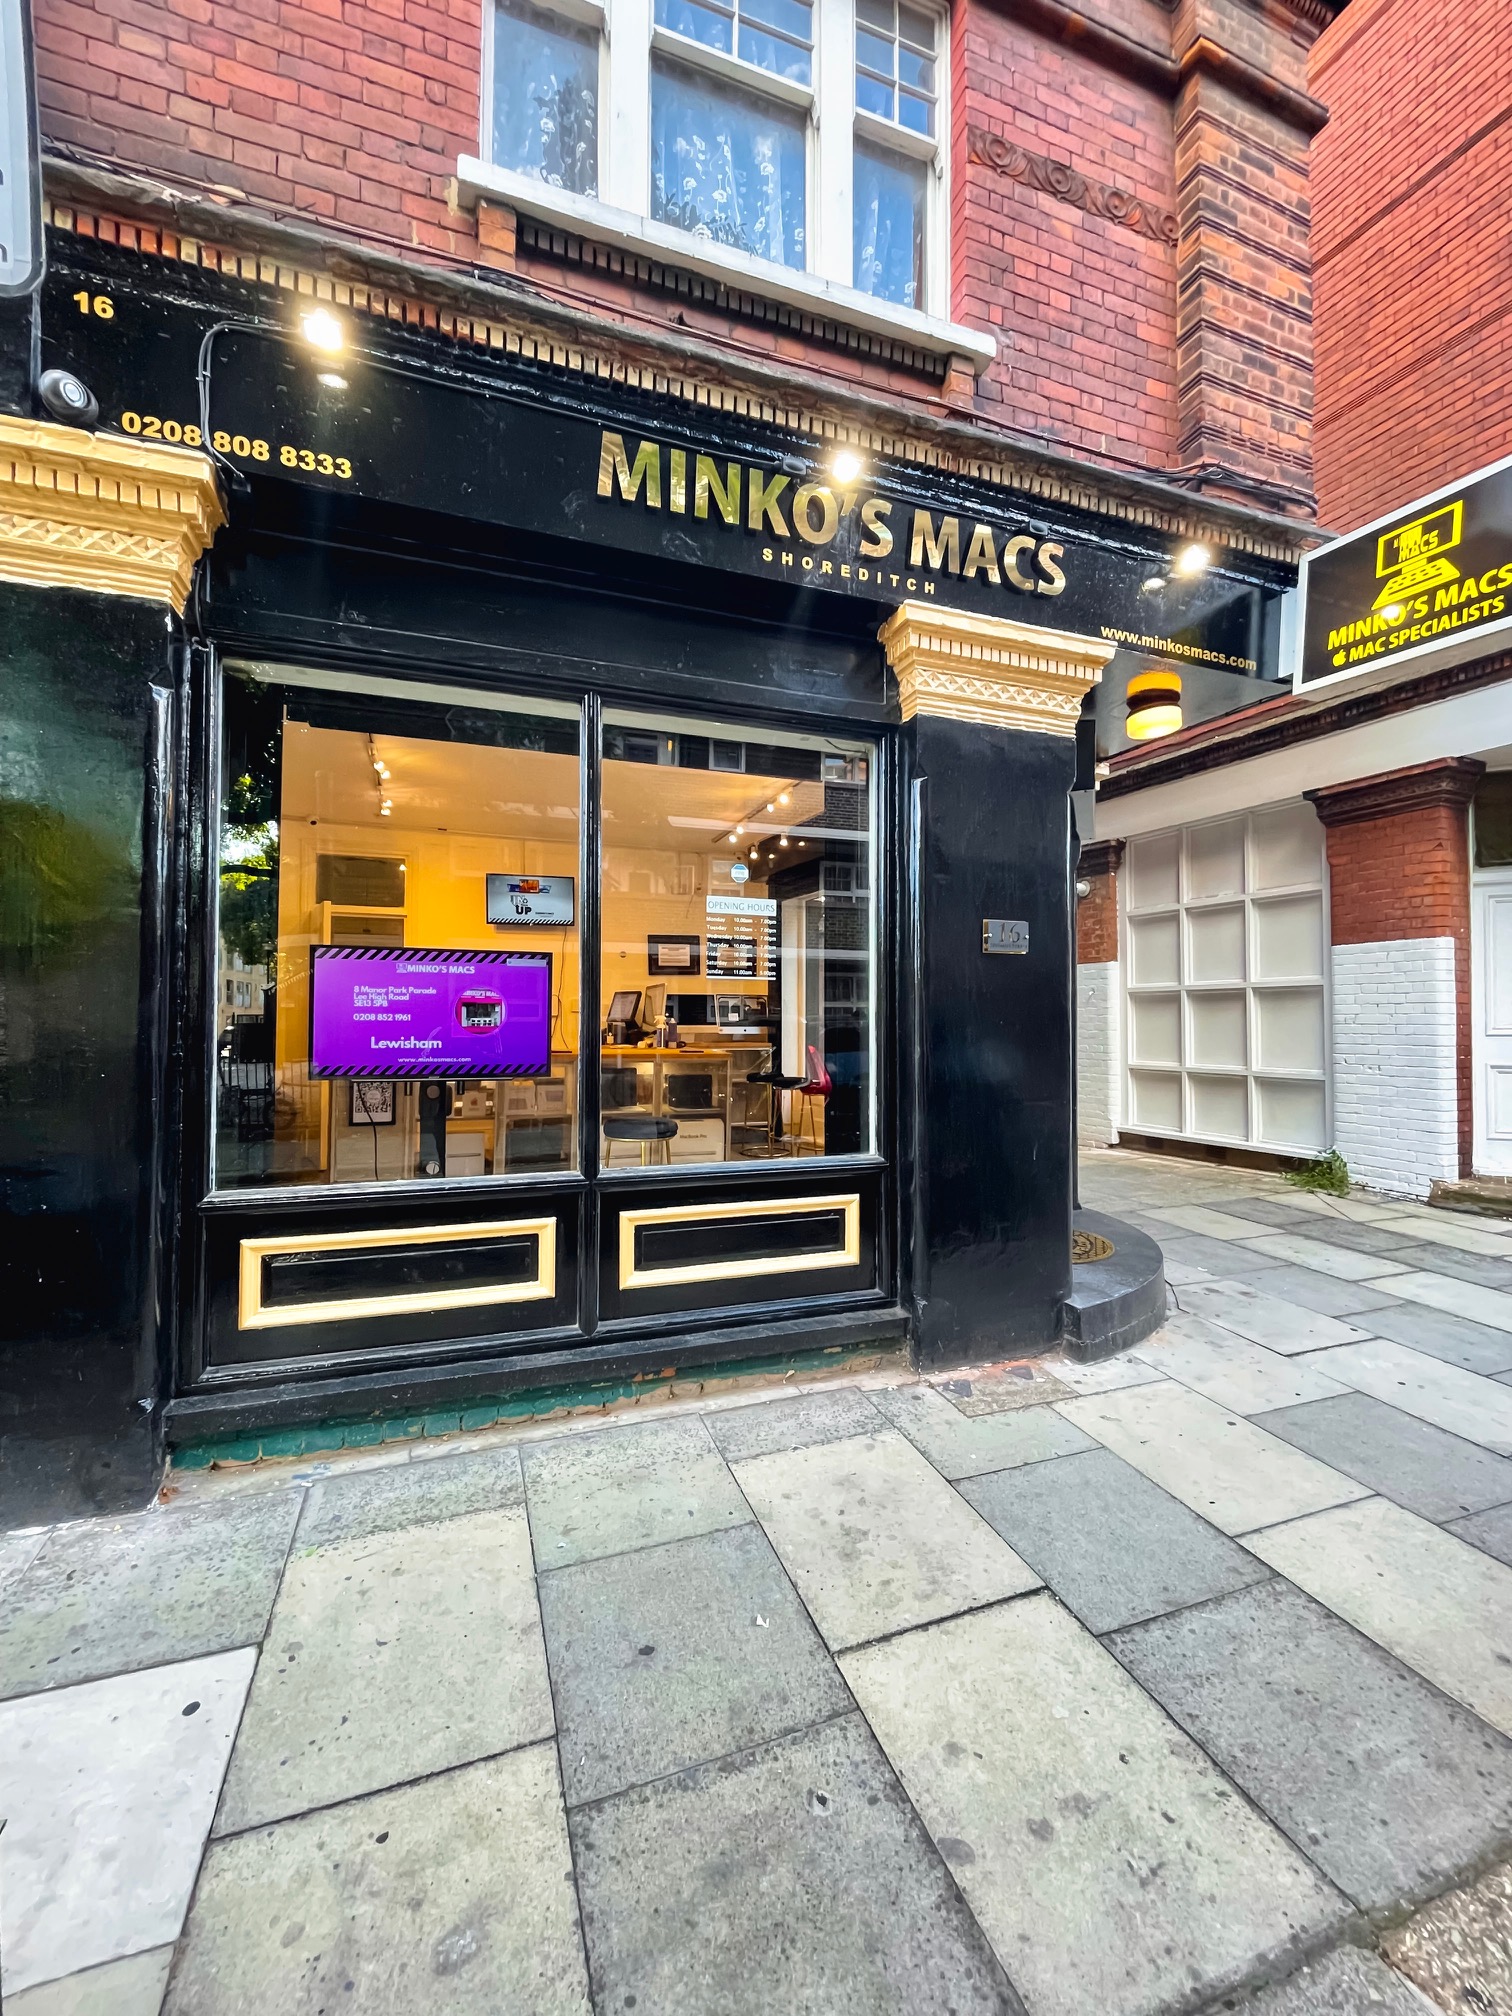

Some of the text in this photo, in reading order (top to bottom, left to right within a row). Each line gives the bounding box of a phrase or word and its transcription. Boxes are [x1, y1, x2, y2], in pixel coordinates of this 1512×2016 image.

[73, 291, 115, 319] 16
[121, 411, 352, 479] 0208 808 8333
[596, 430, 1067, 596] MINKO'S MACS
[762, 548, 936, 595] SHOREDITCH
[1327, 563, 1512, 651] MINKO'S MACS
[1349, 594, 1505, 663] MAC SPECIALISTS
[1101, 625, 1257, 671] www.minkosmacs.com
[516, 904, 532, 914] UP
[708, 901, 775, 912] OPENING HOURS
[999, 922, 1020, 943] 16
[407, 964, 475, 974] MINKO'S MACS
[370, 1036, 442, 1049] Lewisham
